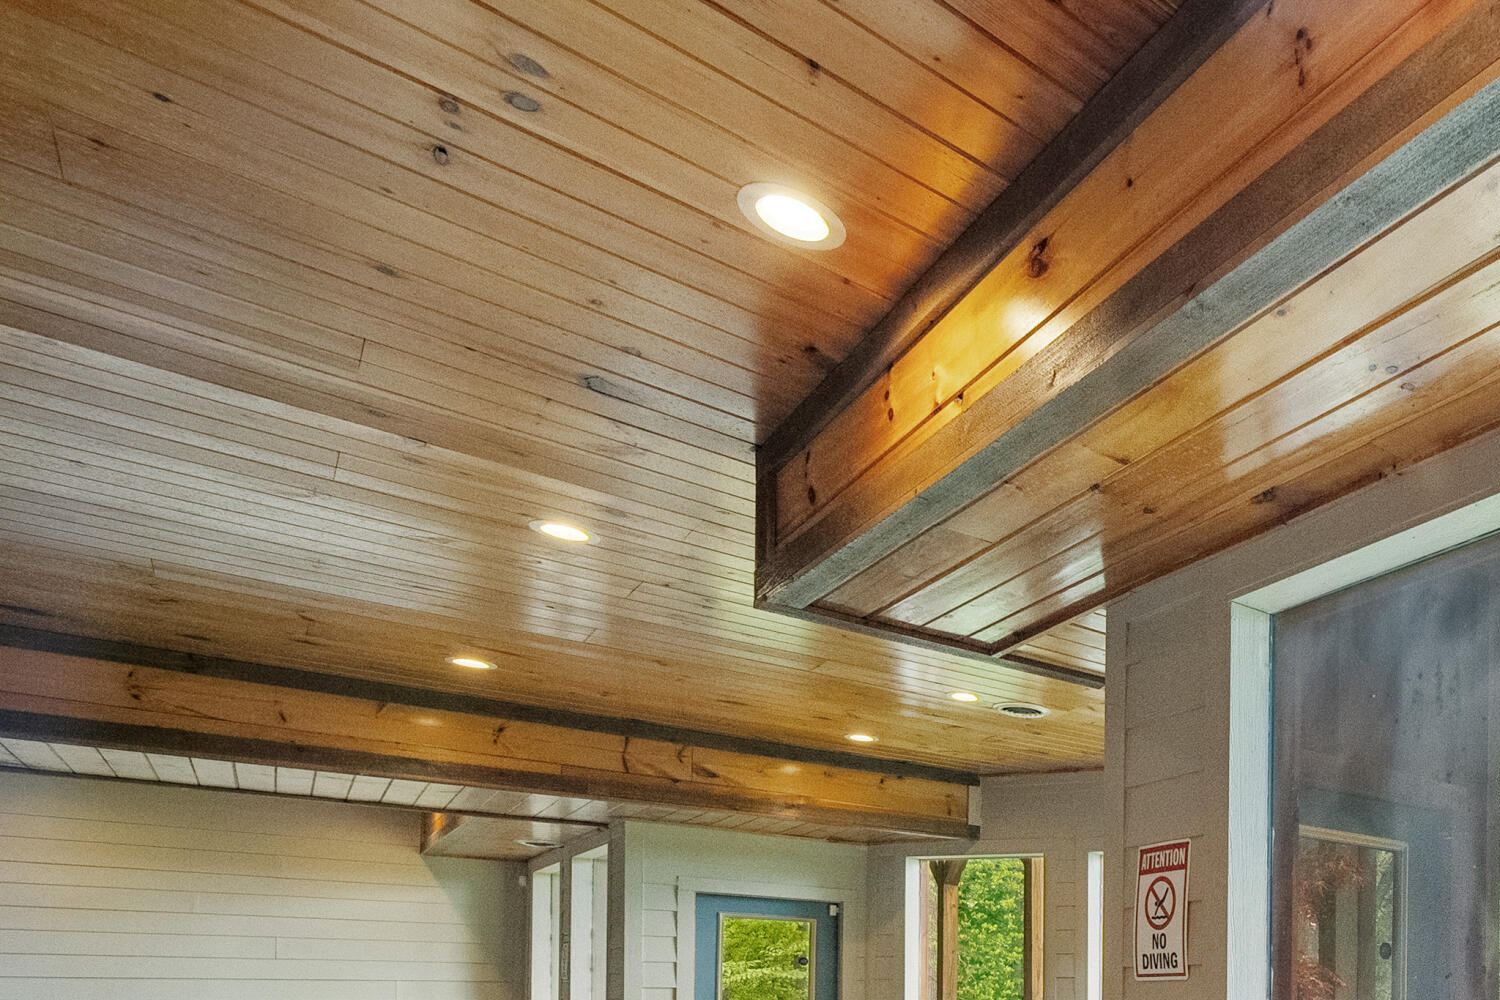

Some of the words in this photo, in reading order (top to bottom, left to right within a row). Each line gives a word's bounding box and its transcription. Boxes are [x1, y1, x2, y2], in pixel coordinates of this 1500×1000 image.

[1142, 848, 1185, 870] ATTENTION
[1152, 933, 1166, 949] NO
[1142, 952, 1178, 969] DIVING
